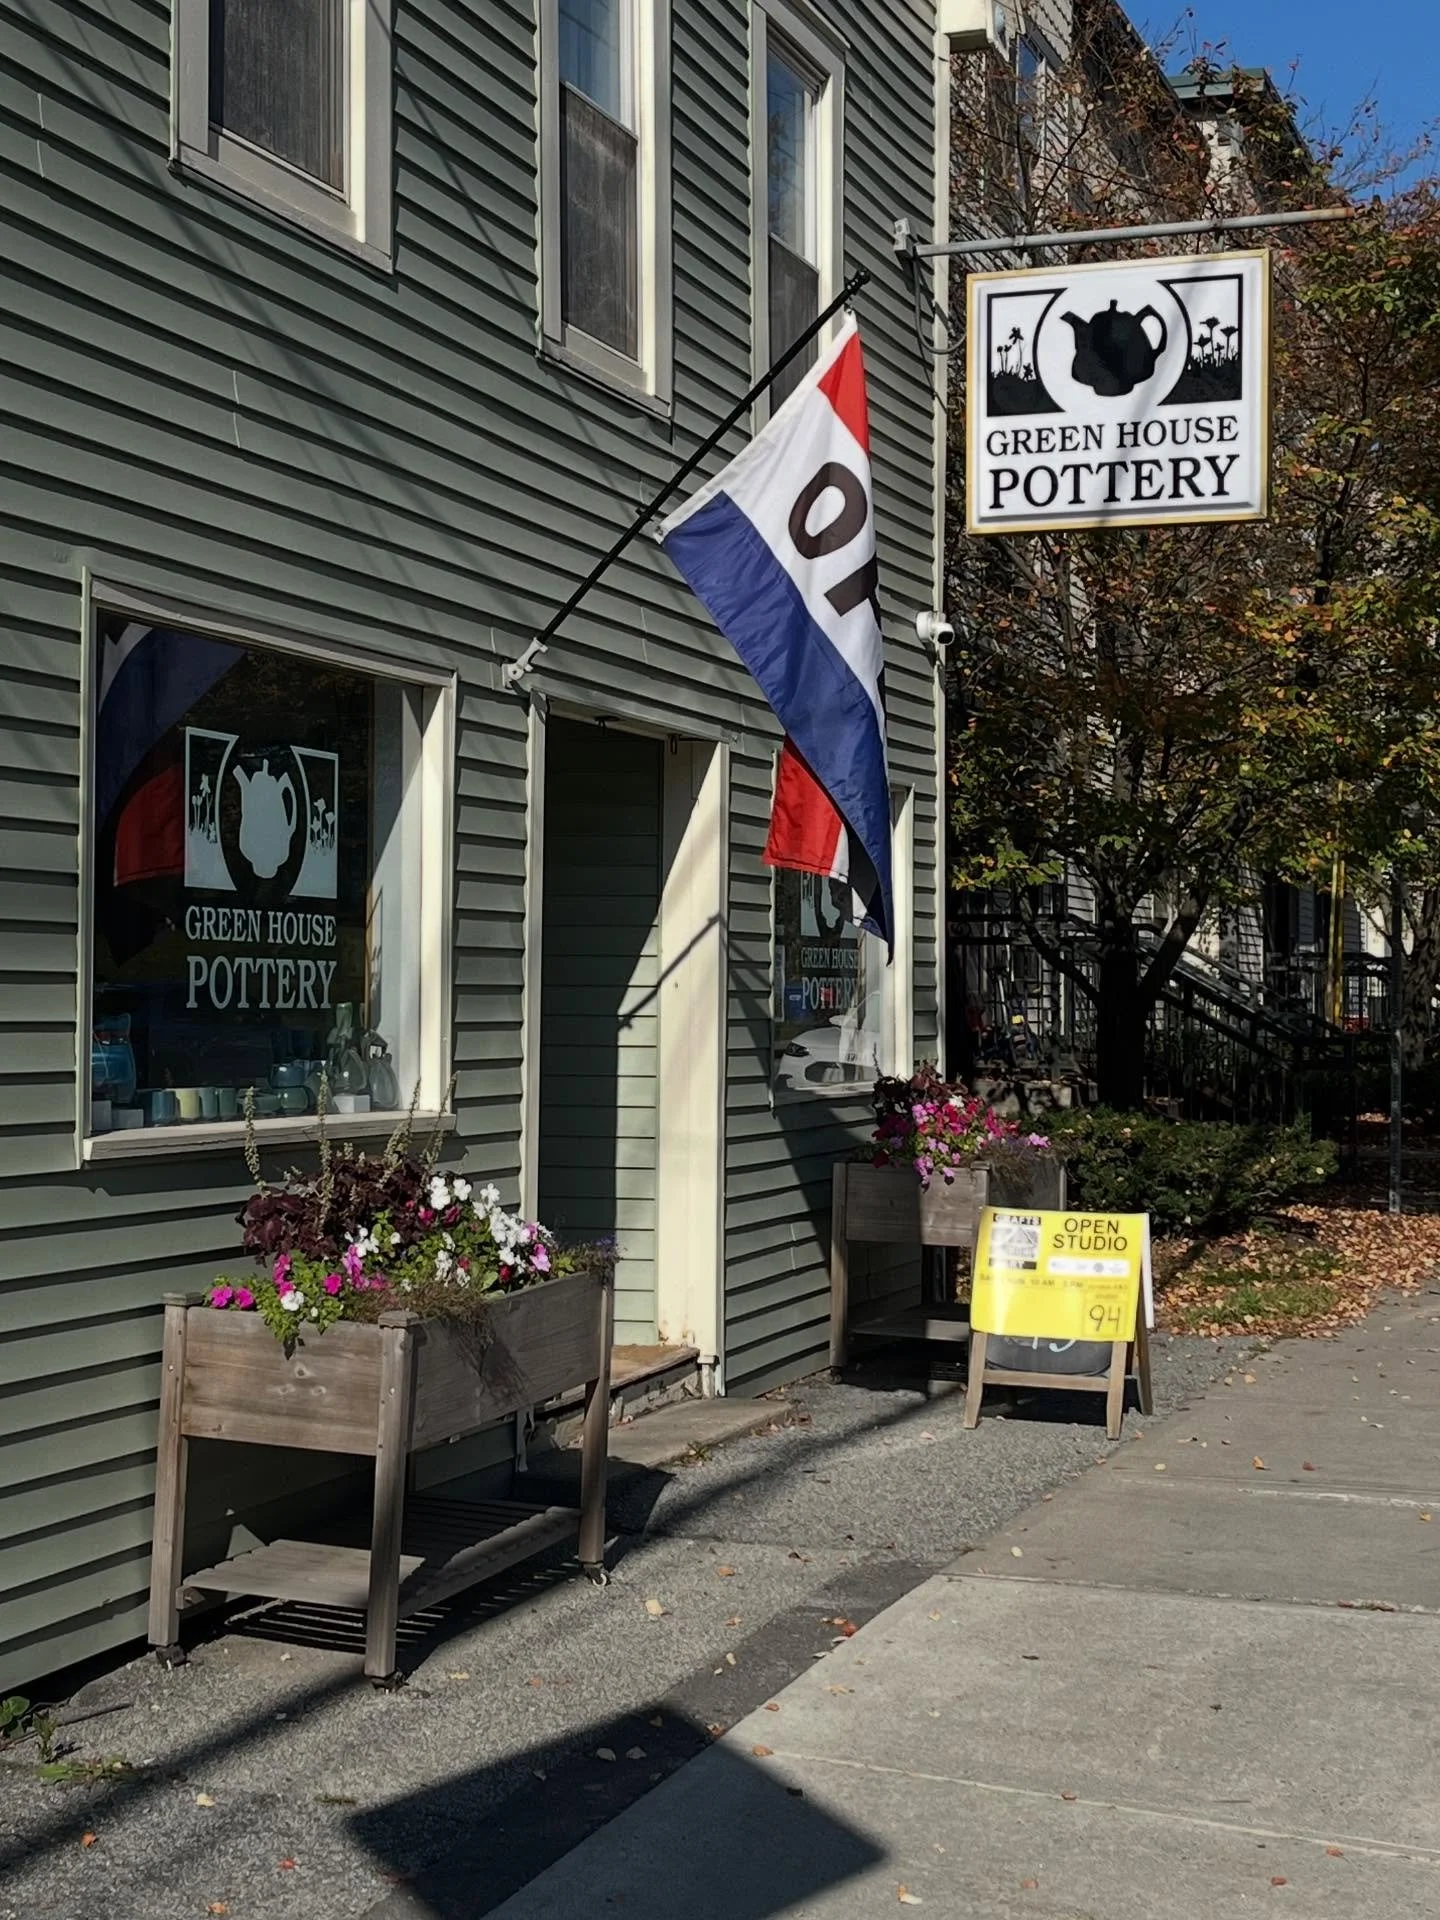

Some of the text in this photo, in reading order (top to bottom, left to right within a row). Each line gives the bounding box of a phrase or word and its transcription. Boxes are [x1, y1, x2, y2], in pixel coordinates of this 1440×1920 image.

[986, 415, 1239, 457] GREEN HOUSE
[988, 454, 1240, 510] POTTERY
[185, 905, 337, 947] GREEN HOUSE
[800, 946, 858, 969] GREEN HOUSE
[185, 955, 337, 1009] POTTERY
[801, 976, 858, 1010] POTTERY
[1053, 1233, 1128, 1251] STUDIO
[1064, 1217, 1120, 1235] OPEN
[1089, 1304, 1121, 1333] 94
